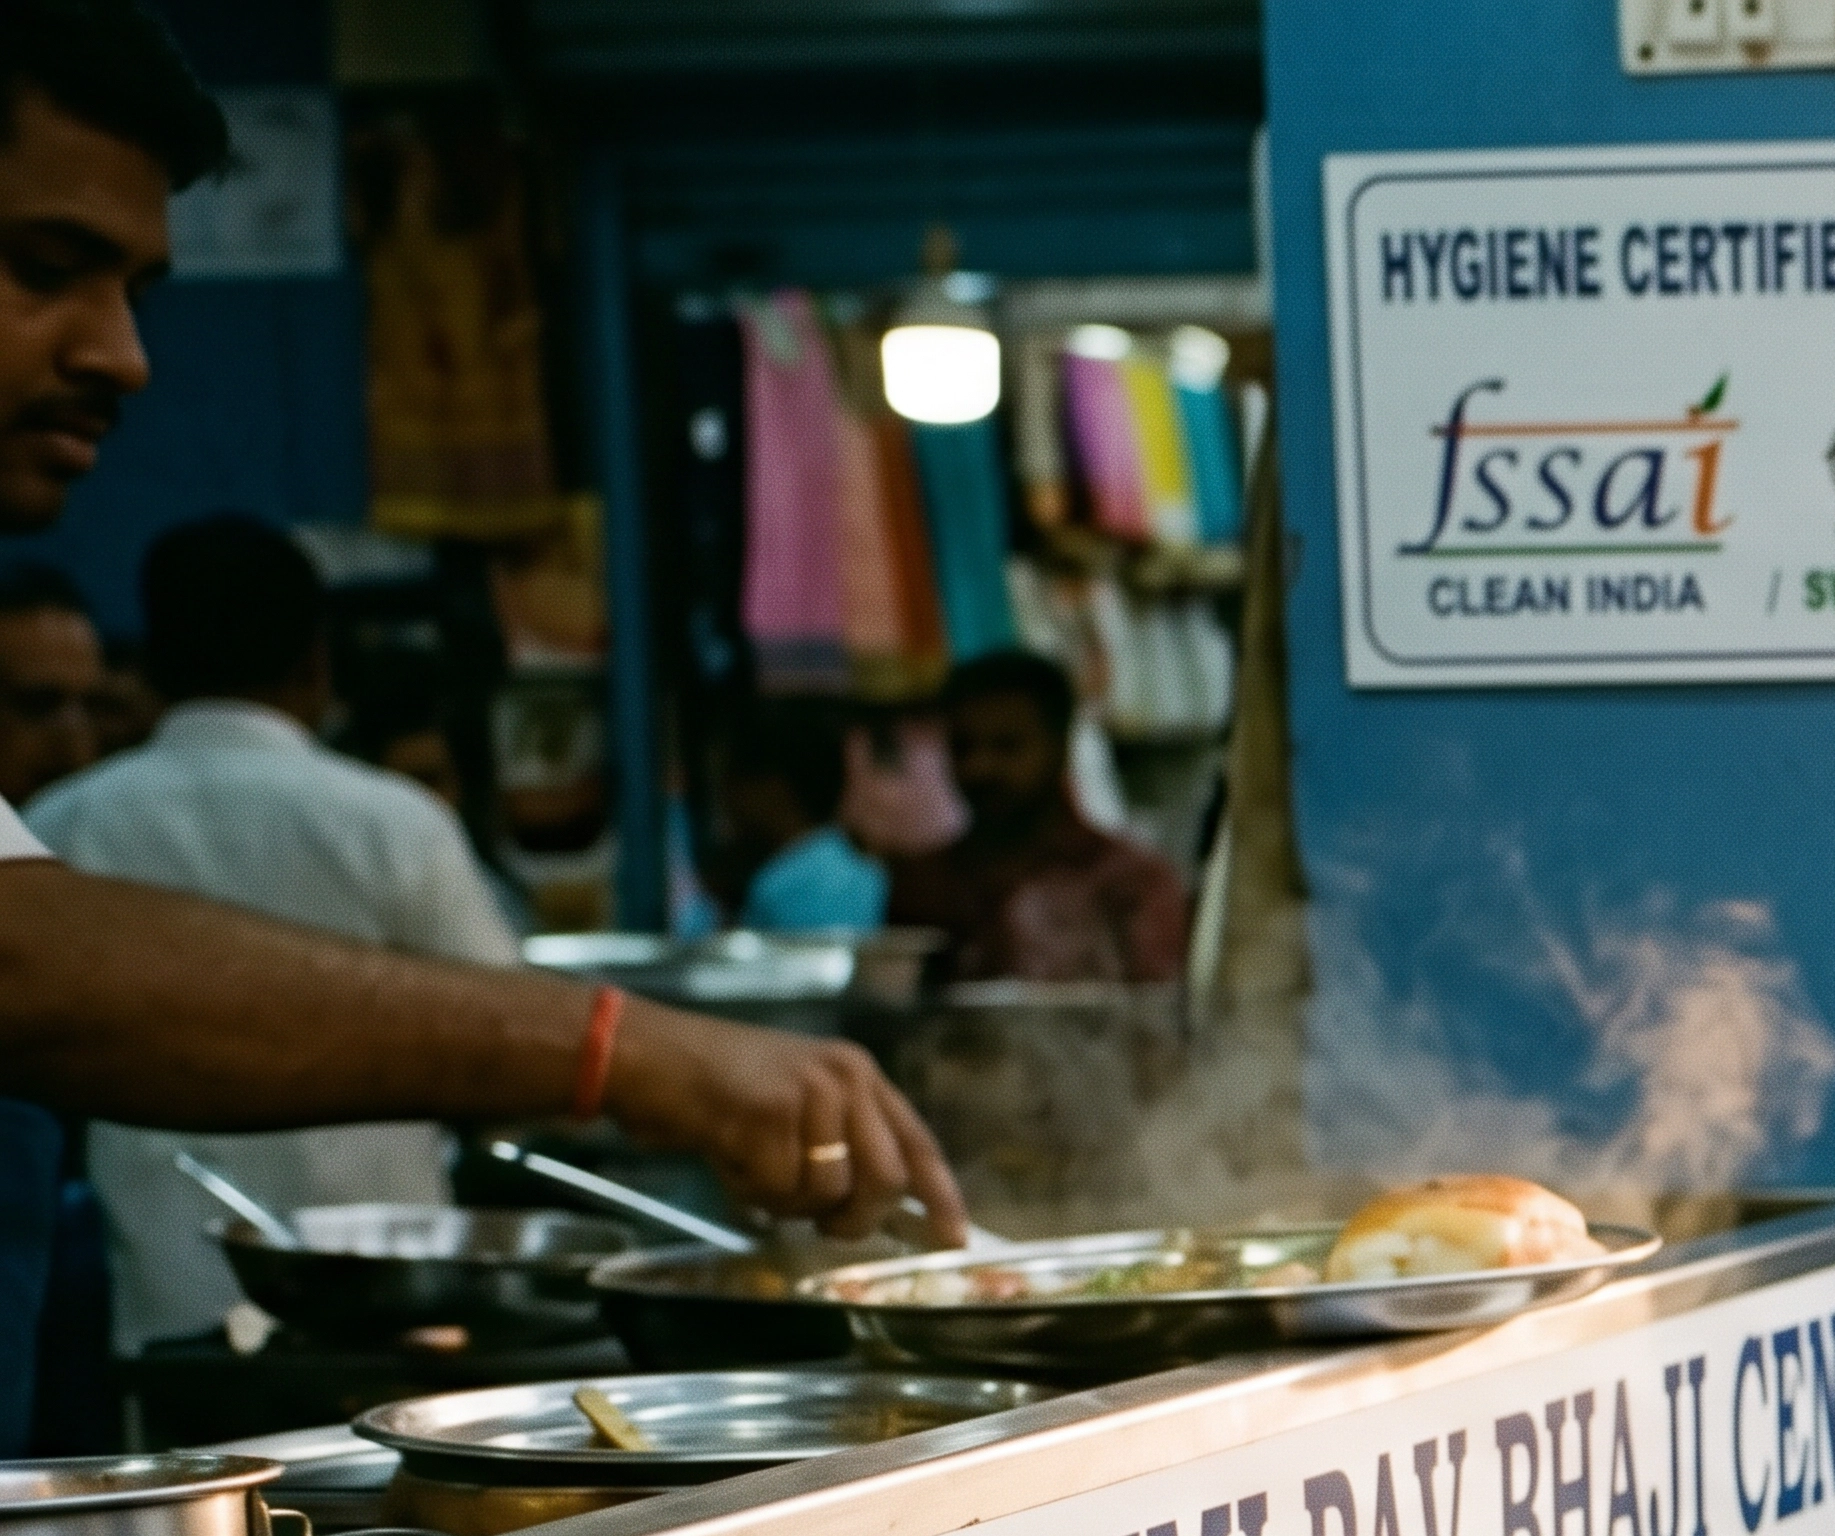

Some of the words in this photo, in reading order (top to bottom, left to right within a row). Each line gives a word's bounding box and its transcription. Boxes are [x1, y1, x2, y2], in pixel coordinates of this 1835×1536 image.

[1380, 224, 1603, 303] HYGIENE
[1396, 376, 1736, 558] fssai
[1426, 575, 1571, 618] CLEAN
[1586, 572, 1706, 614] INDIA
